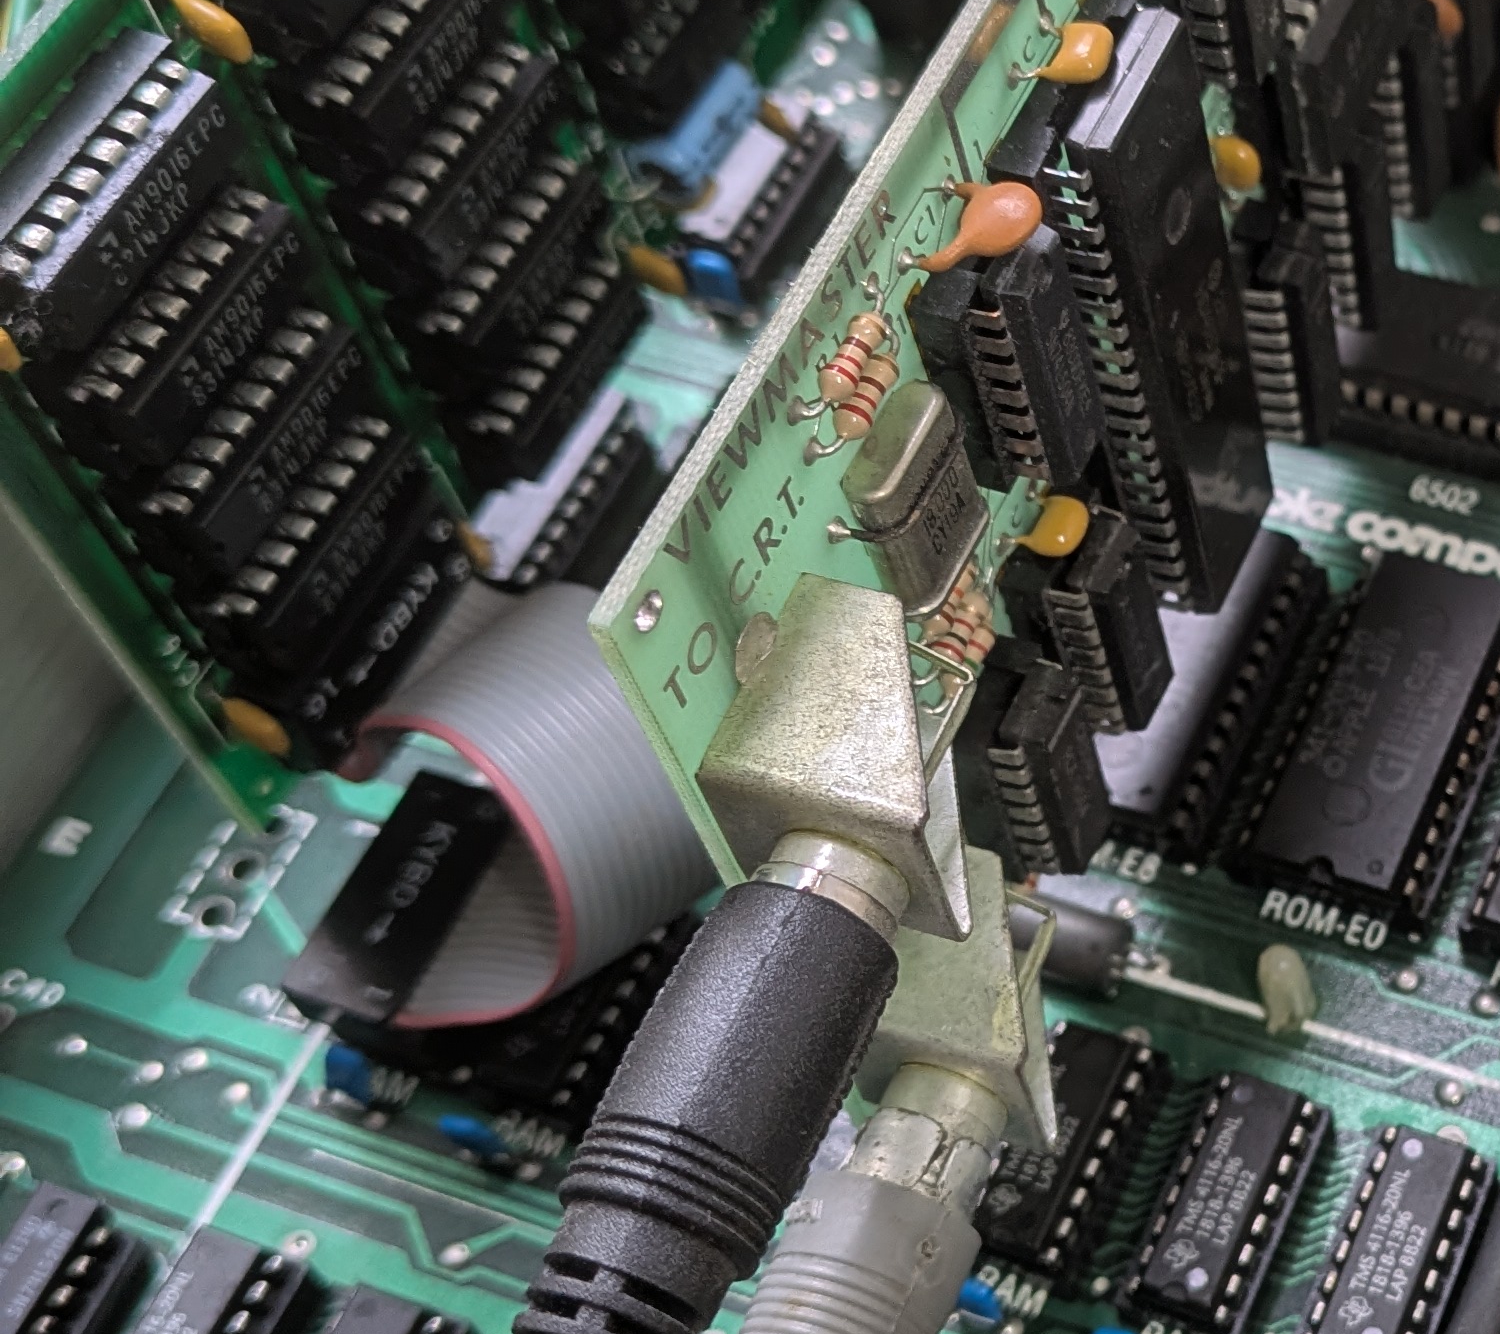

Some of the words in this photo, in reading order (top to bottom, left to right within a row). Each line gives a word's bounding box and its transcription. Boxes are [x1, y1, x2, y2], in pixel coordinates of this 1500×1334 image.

[115, 99, 231, 237] AM9016EPC
[907, 203, 944, 248] C1
[199, 229, 305, 357] AM9016EPC
[651, 189, 917, 567] VIEWMASTER
[715, 475, 814, 607] C.R.T.
[1406, 472, 1482, 517] 6502
[658, 616, 729, 709] TO
[1348, 1249, 1379, 1293] TMS
[1364, 1165, 1412, 1250] 4116-20NL
[1365, 1207, 1415, 1297] 1818-1396
[1383, 1265, 1411, 1303] LAP
[1397, 1223, 1428, 1268] 8822
